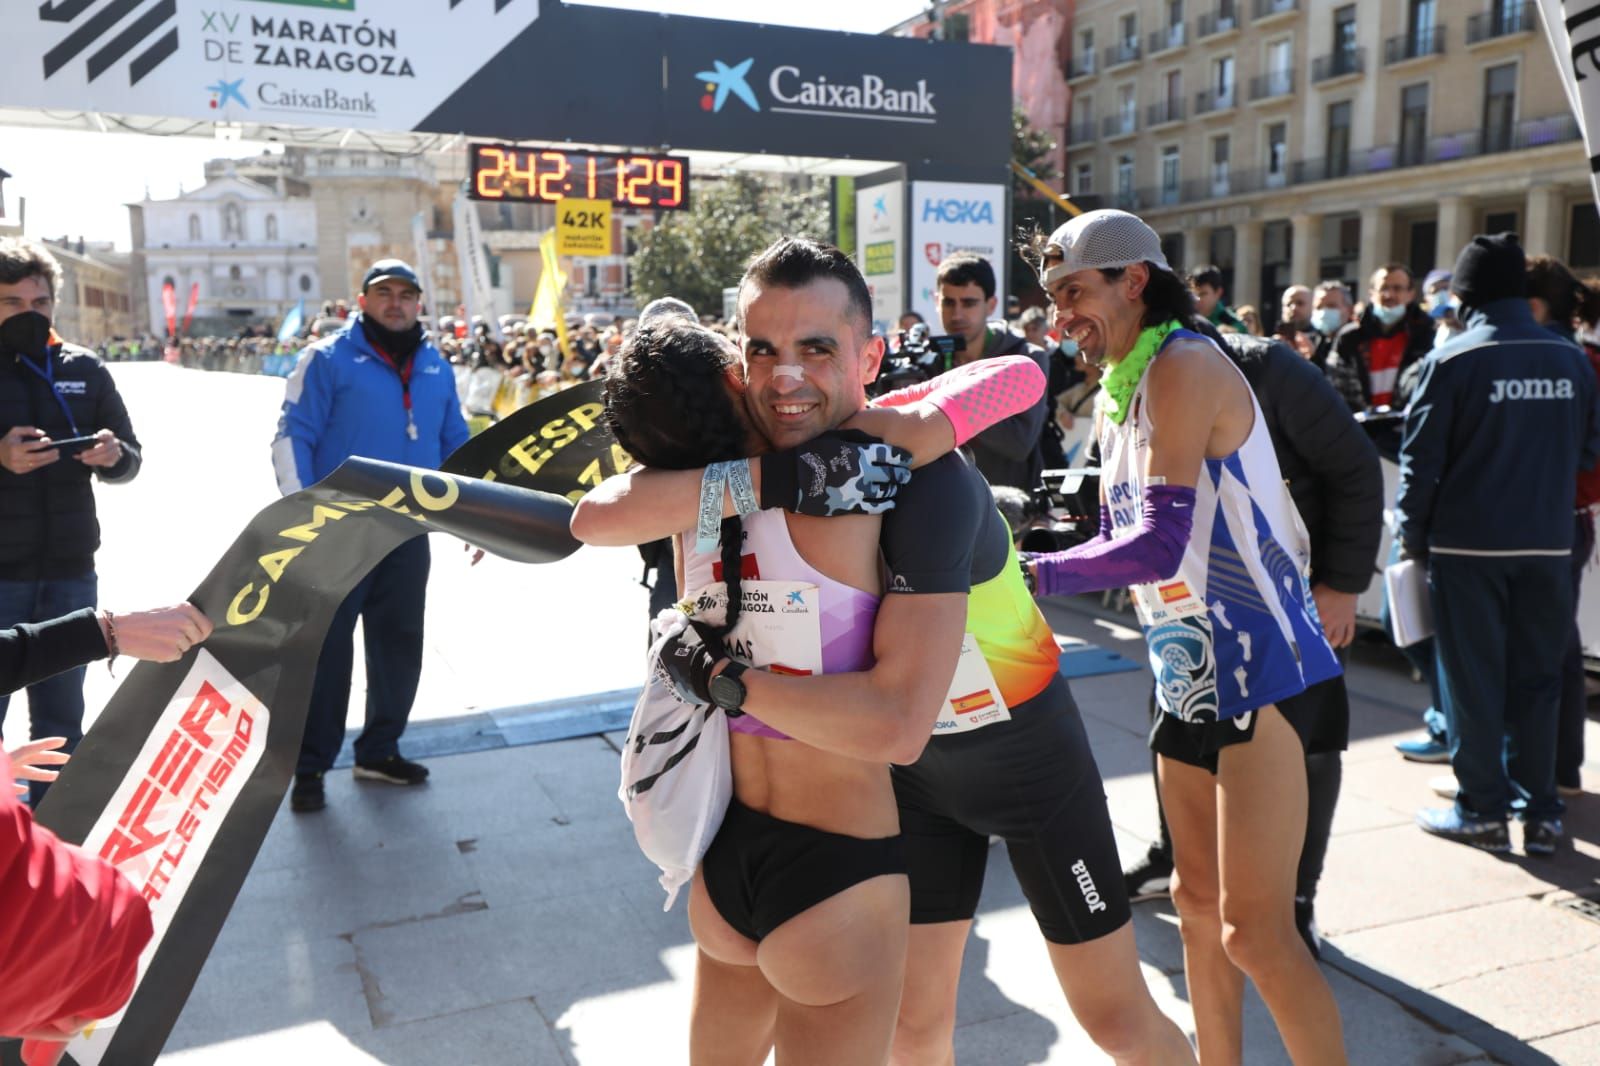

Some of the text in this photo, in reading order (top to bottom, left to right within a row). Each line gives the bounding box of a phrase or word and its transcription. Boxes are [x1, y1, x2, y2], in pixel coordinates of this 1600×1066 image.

[201, 11, 397, 49] XV MARATÓN
[204, 39, 416, 78] DE ZARAGOZA
[257, 81, 377, 113] CaixaBank
[769, 65, 937, 115] CaixaBank
[563, 210, 605, 229] 42K
[922, 199, 994, 224] HOKA
[741, 589, 769, 602] ATÓN
[935, 721, 958, 729] OKA
